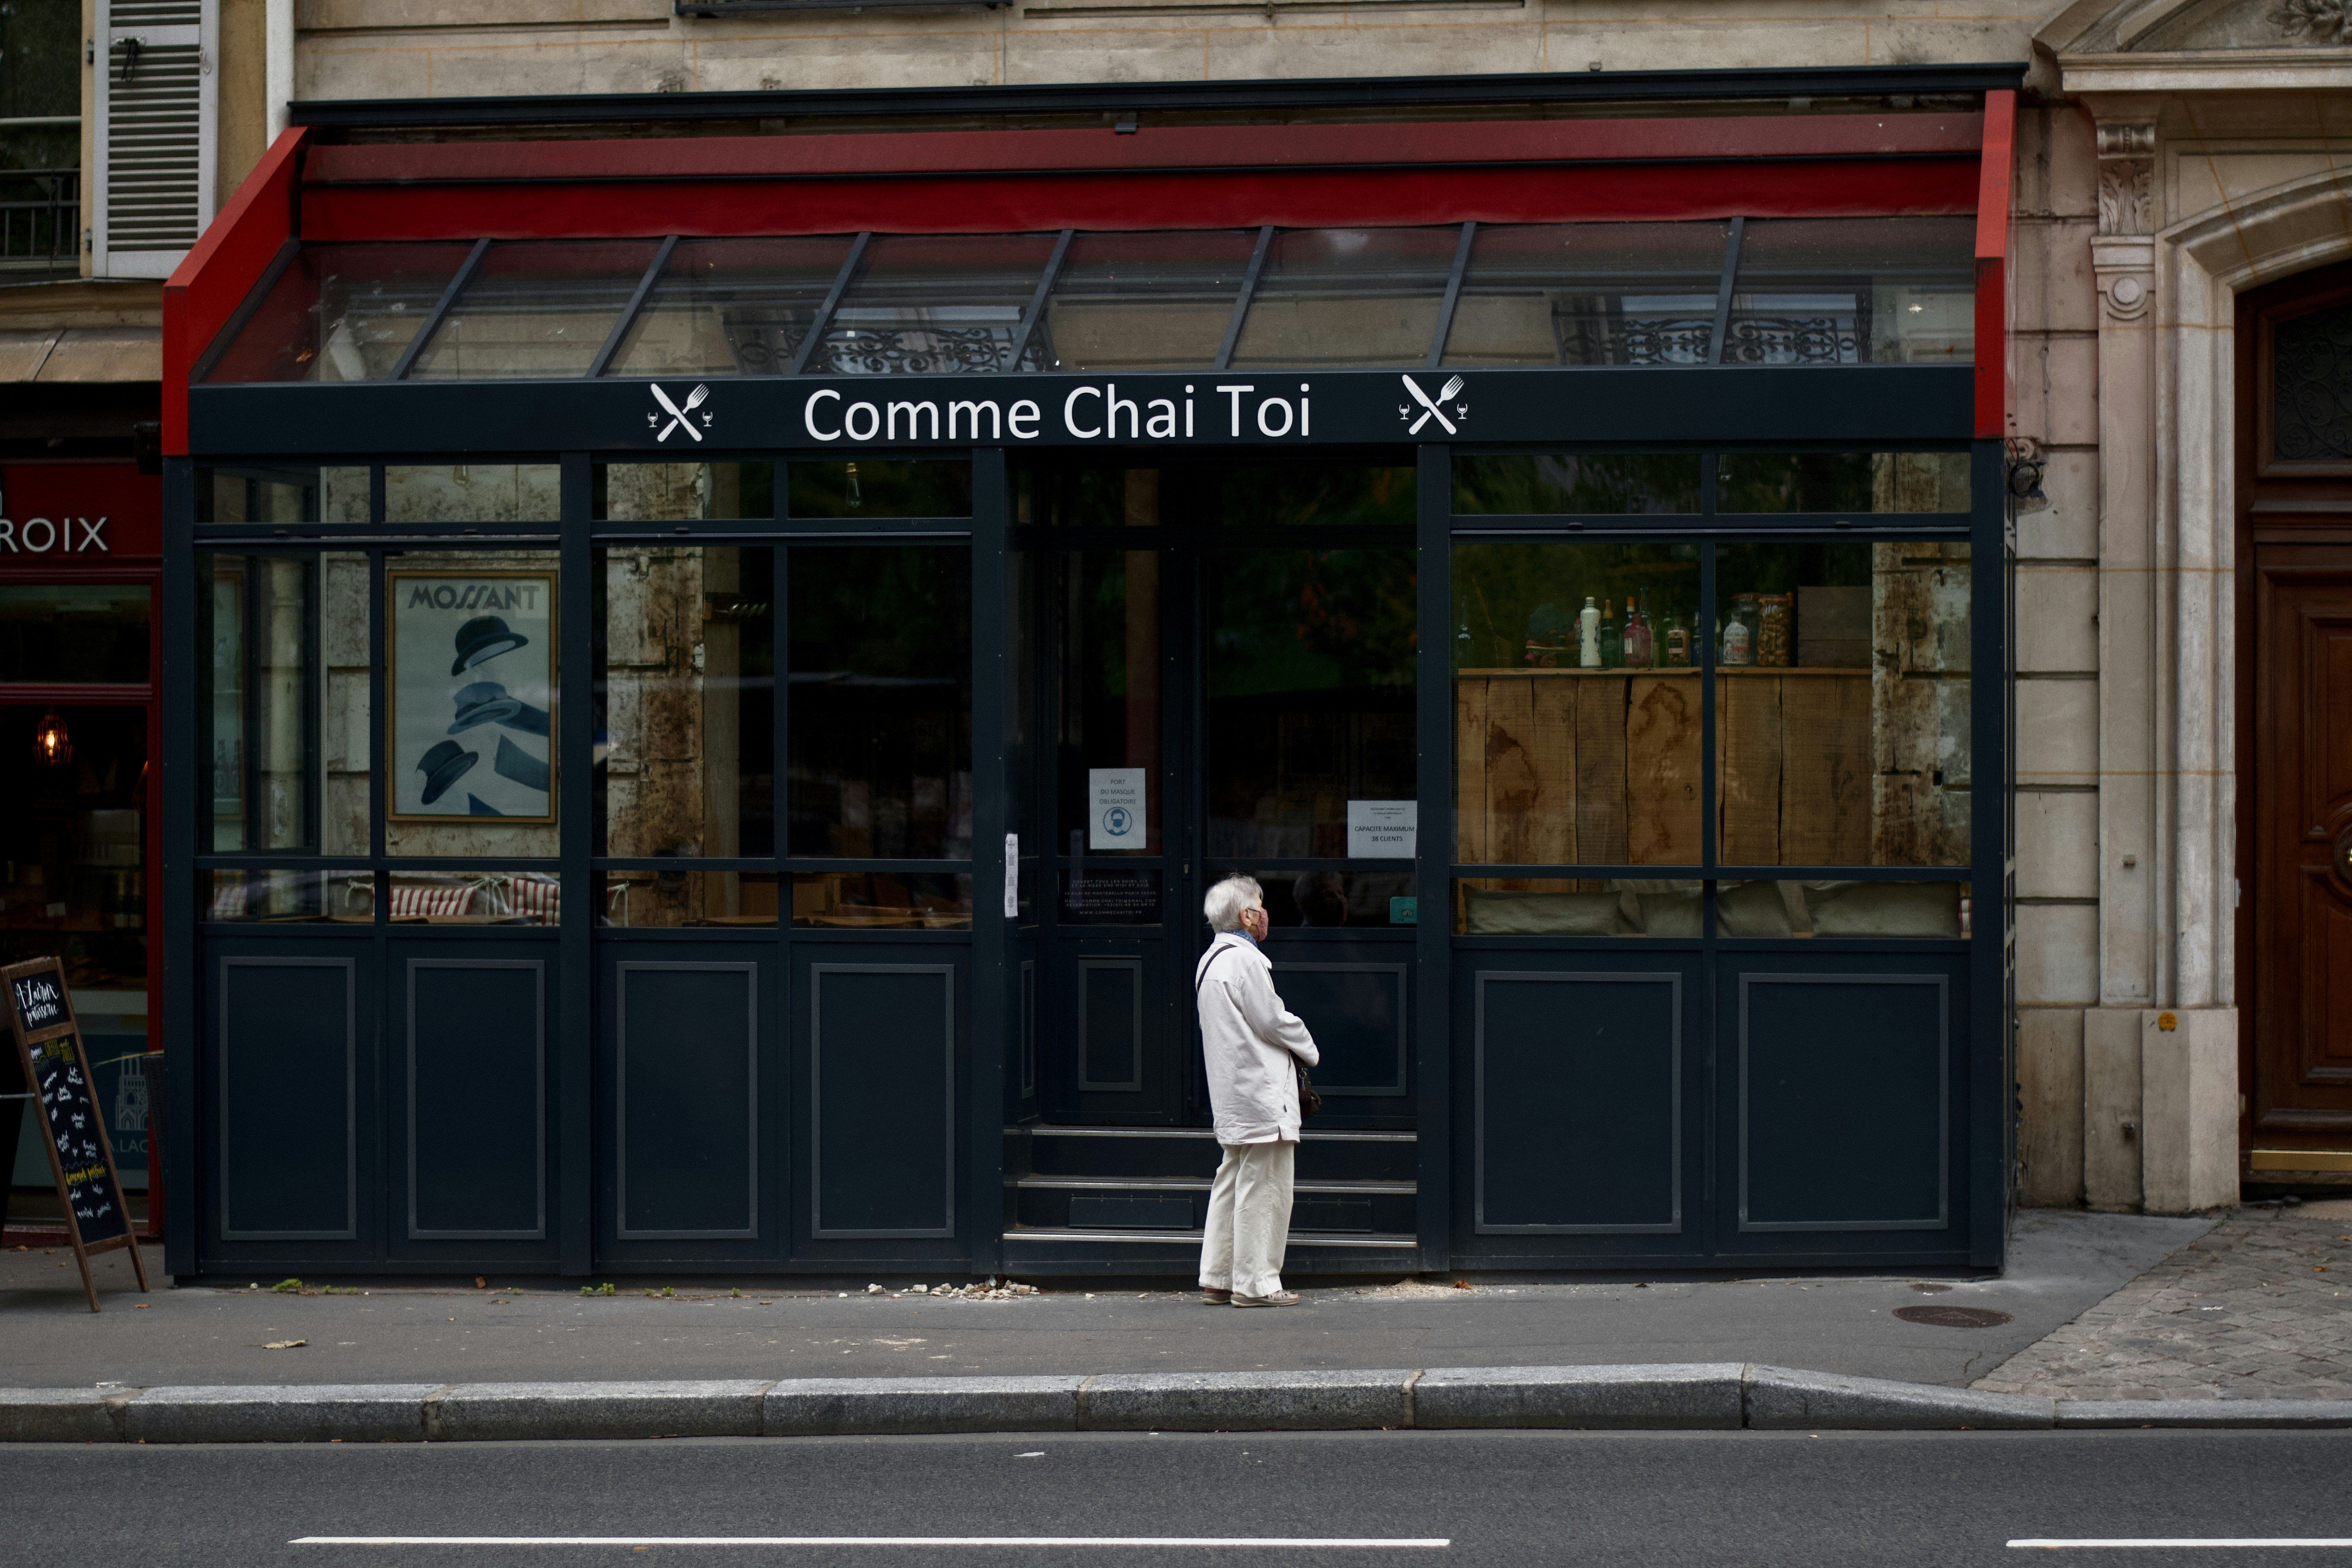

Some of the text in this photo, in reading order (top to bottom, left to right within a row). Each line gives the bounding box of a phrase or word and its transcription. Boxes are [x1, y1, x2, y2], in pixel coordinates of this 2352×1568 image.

[805, 383, 1309, 441] Comme Chai Toi
[0, 517, 108, 553] ROIX
[408, 585, 540, 610] MOSSANT
